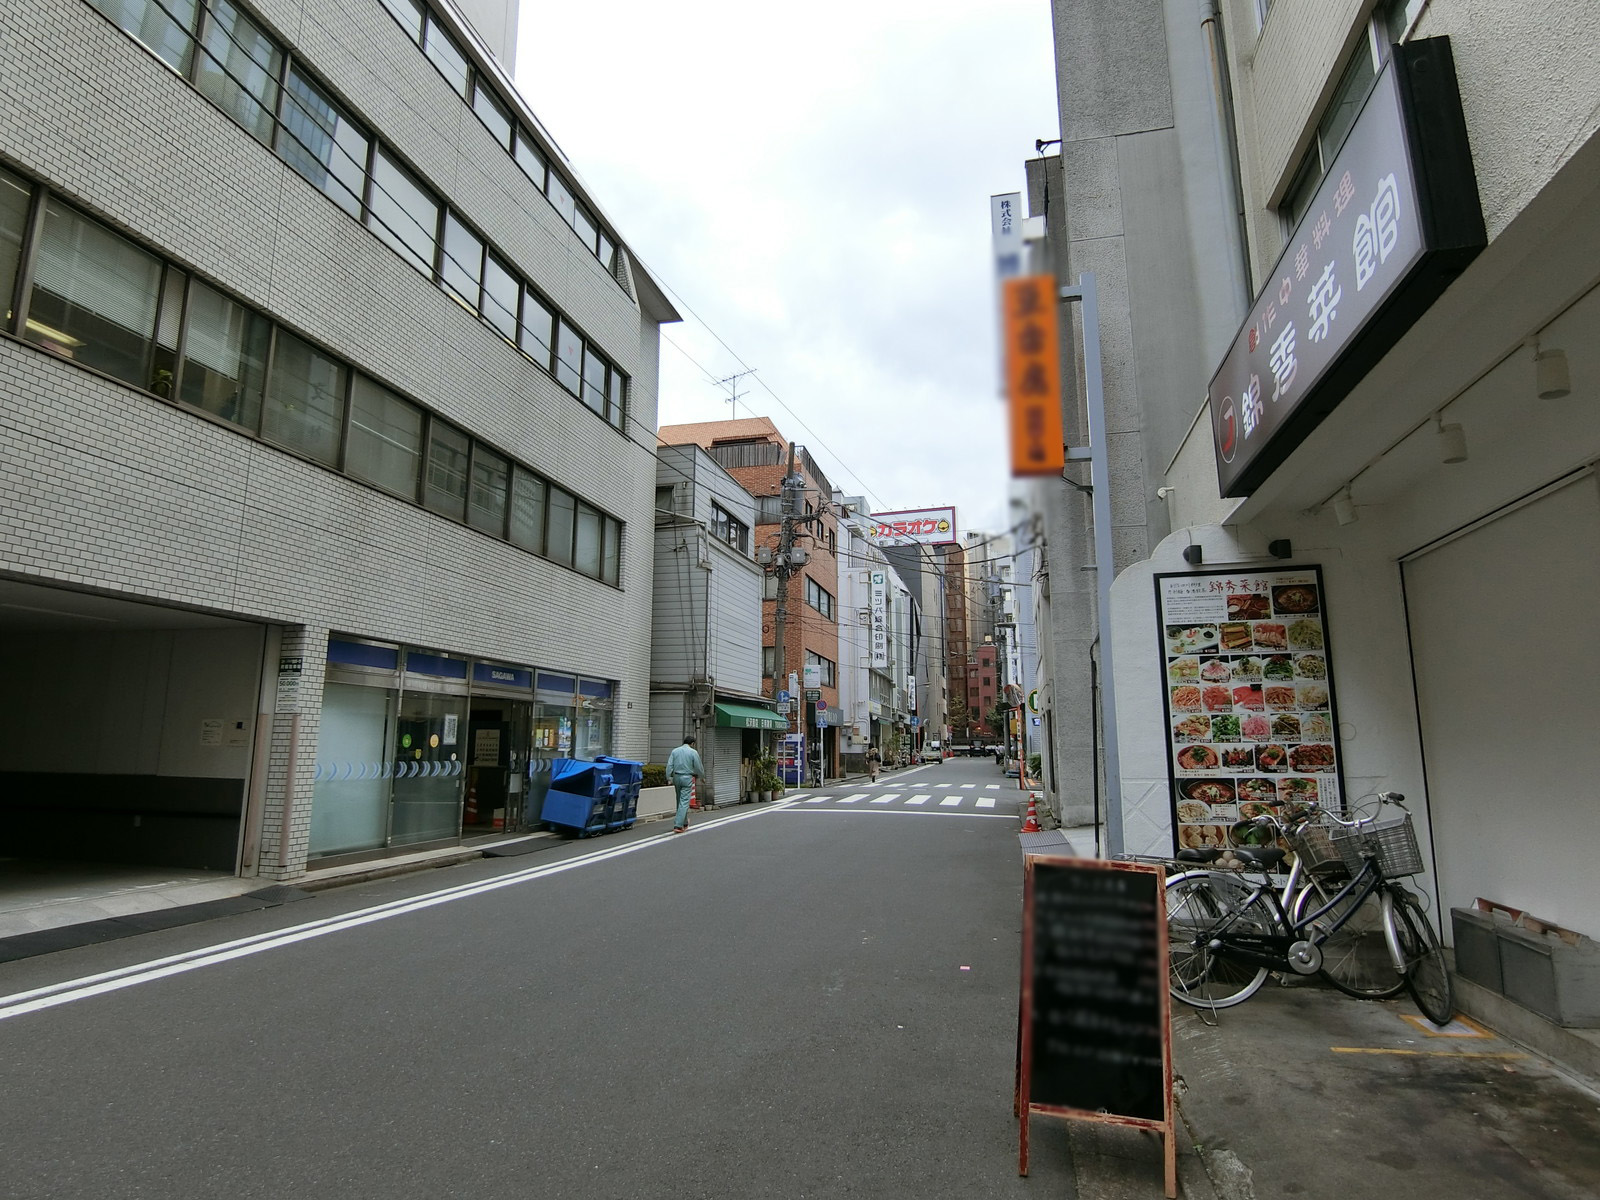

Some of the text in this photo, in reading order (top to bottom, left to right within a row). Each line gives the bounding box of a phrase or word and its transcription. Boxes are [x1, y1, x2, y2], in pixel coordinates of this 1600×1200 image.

[1248, 170, 1356, 354] 創作中華料理
[1241, 172, 1402, 441] 錦秀菜館
[877, 519, 938, 537] カラオケ
[1208, 578, 1269, 594] 錦秀菜館
[491, 670, 515, 681] SAGAWA
